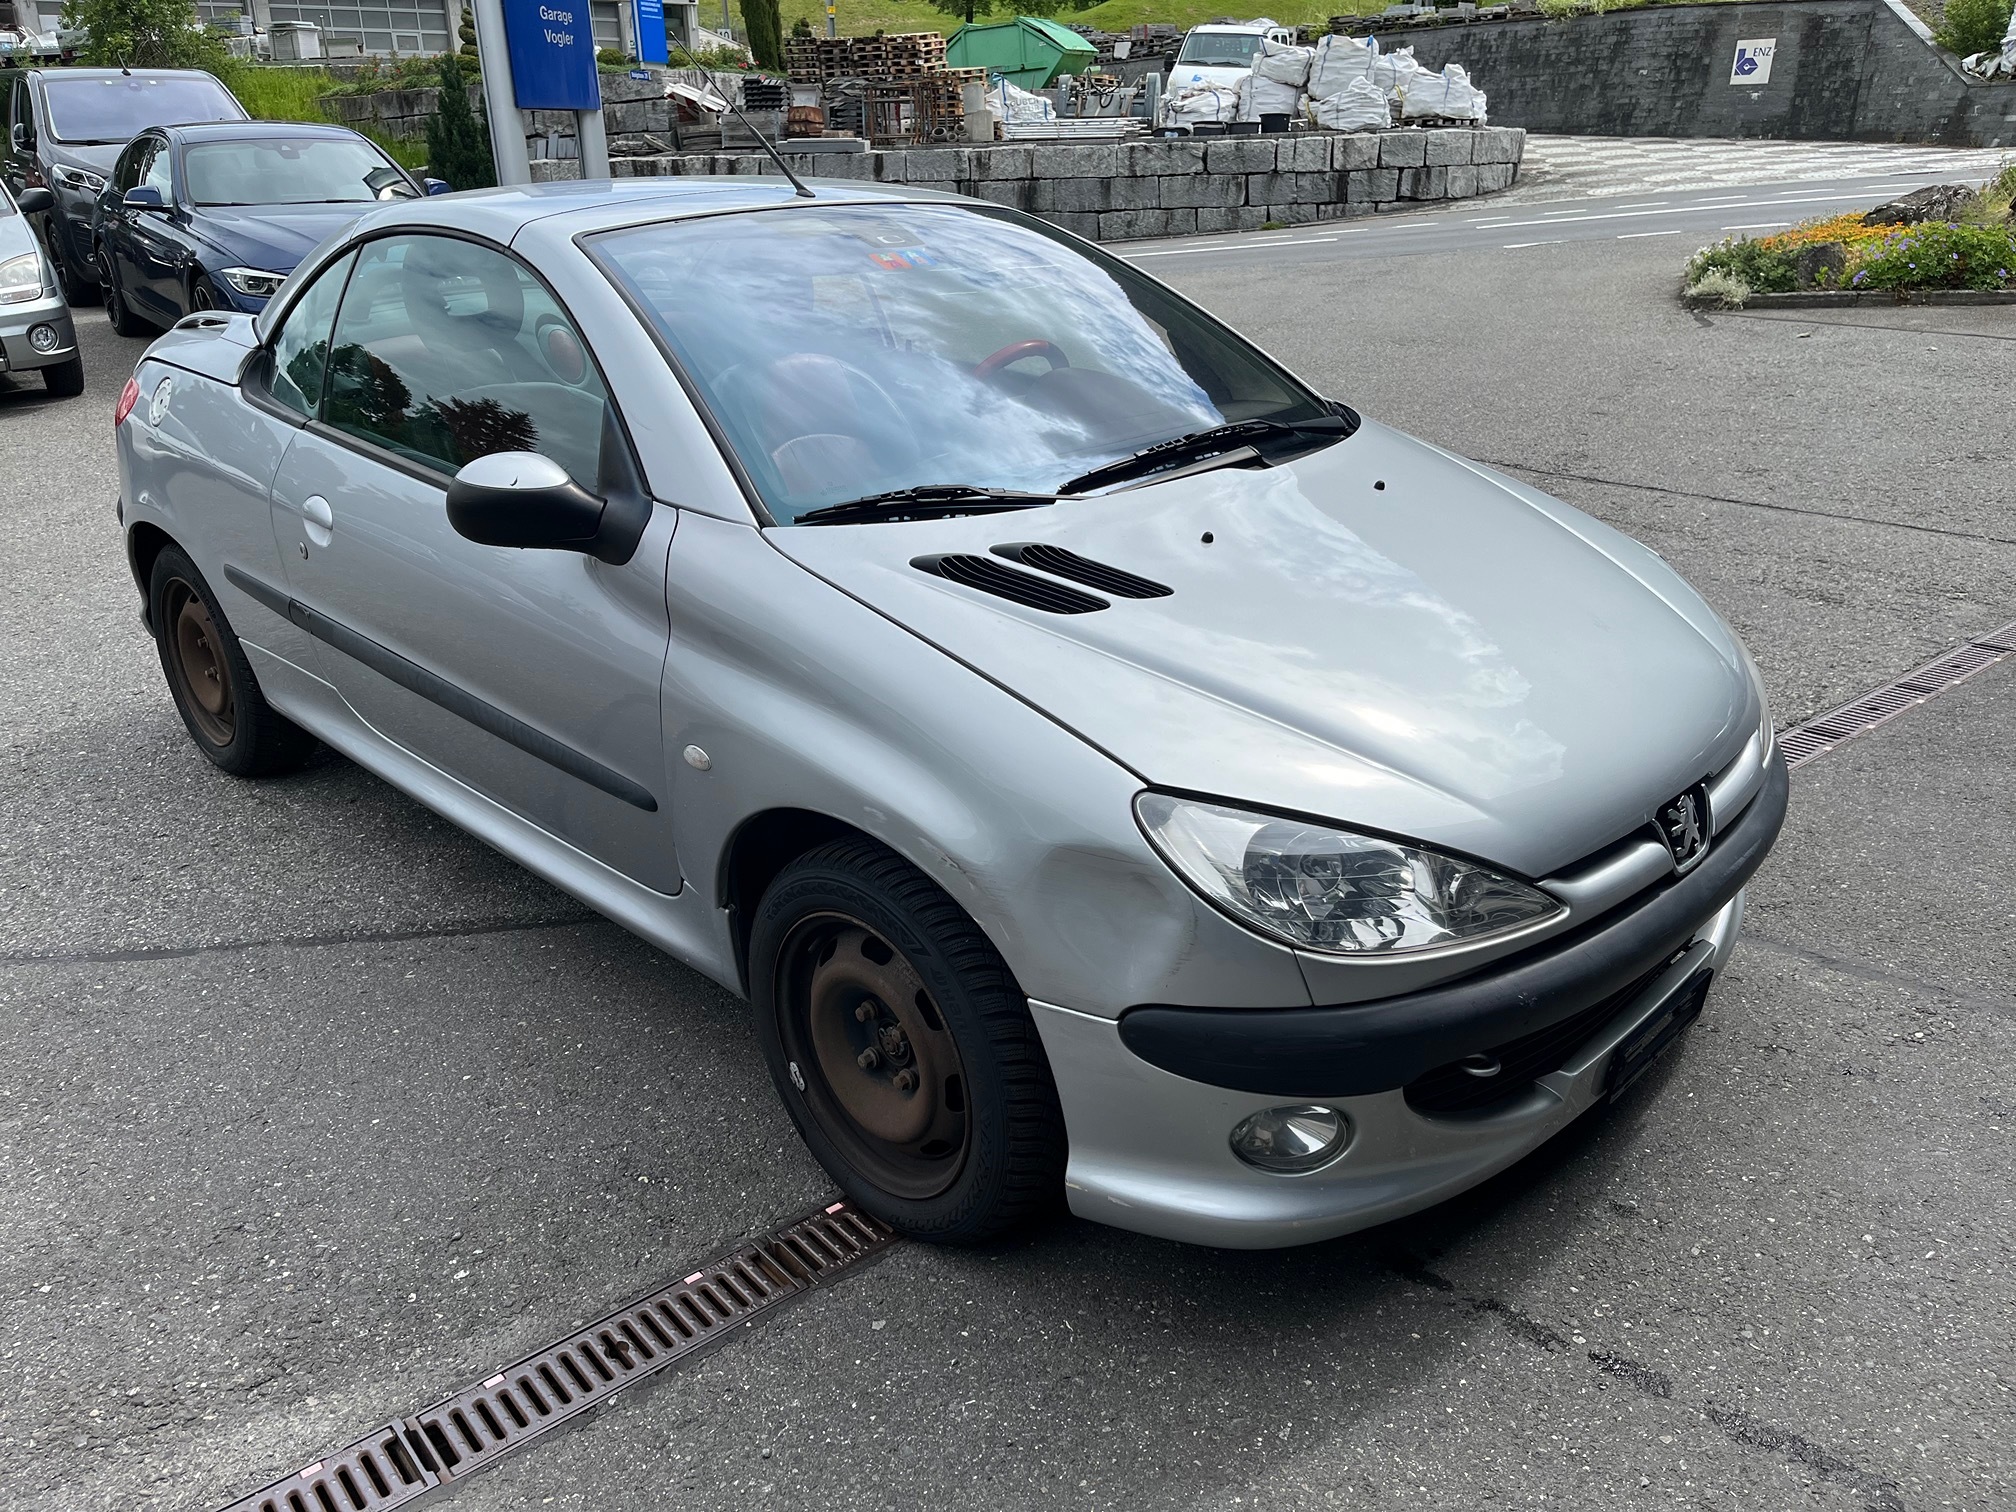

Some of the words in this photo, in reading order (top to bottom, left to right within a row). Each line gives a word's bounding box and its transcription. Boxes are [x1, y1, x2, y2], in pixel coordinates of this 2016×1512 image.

[539, 5, 573, 26] Garage
[543, 28, 574, 47] Vogler
[1753, 47, 1773, 57] ENZ
